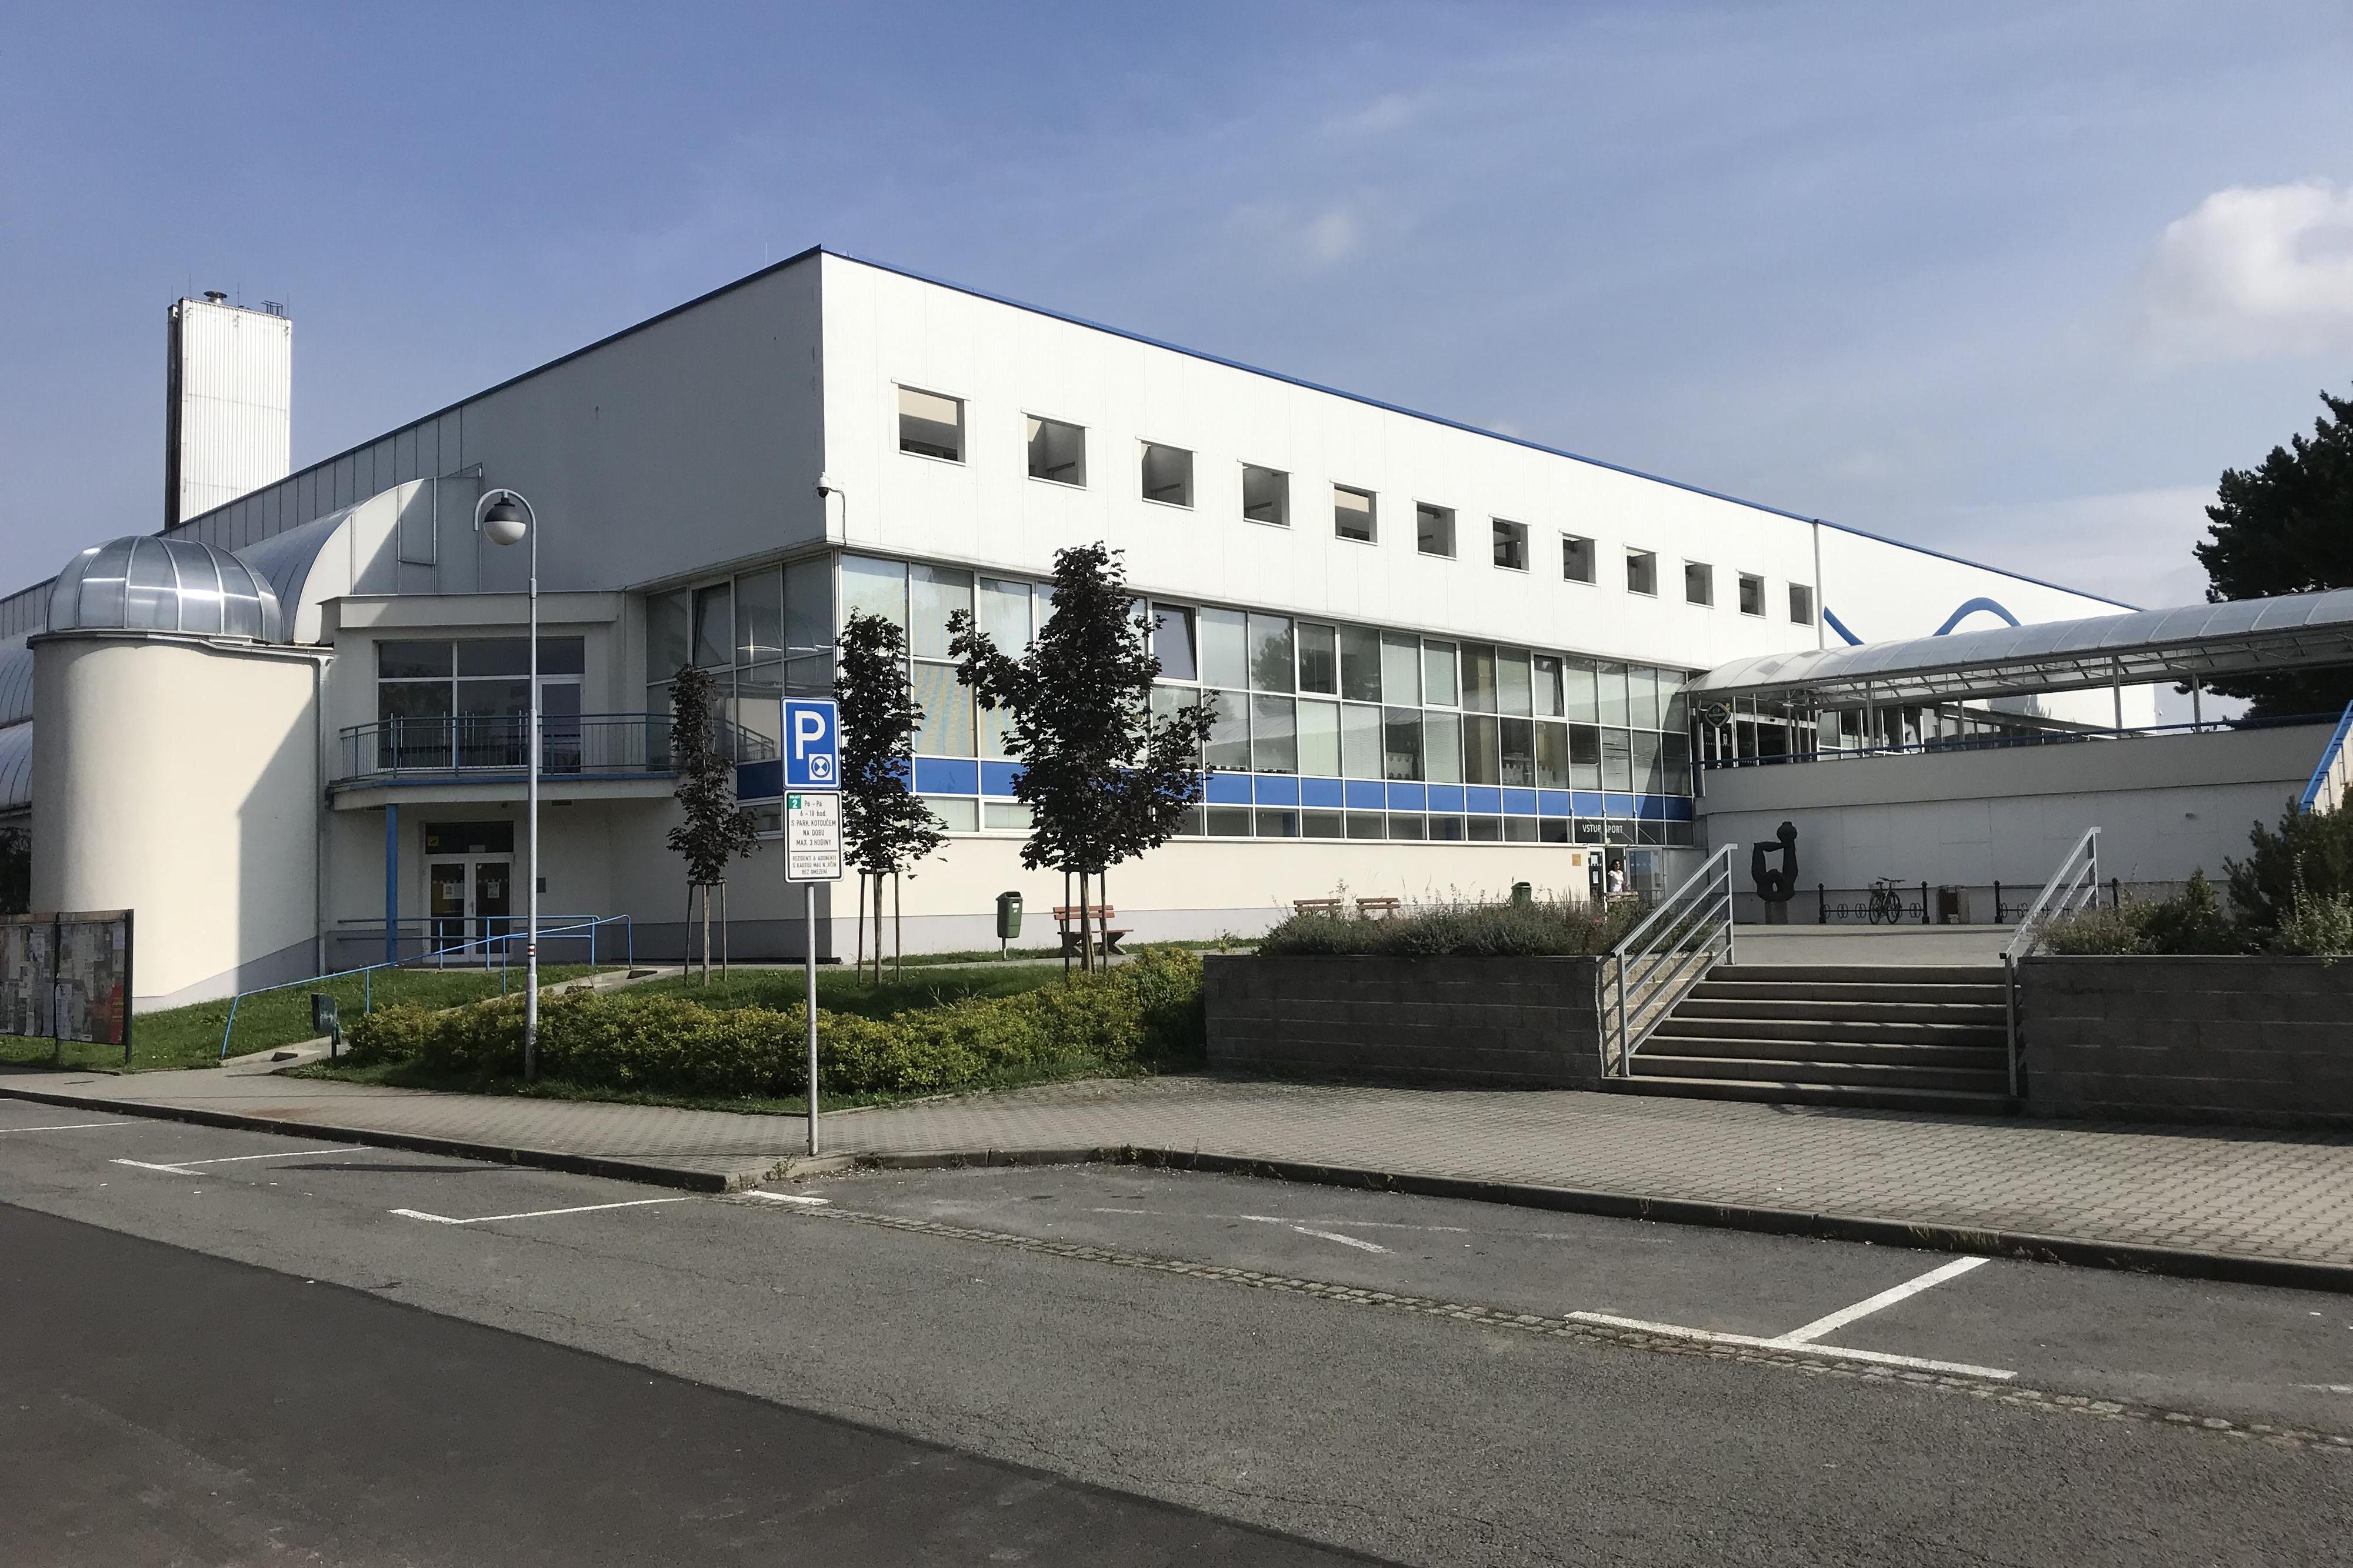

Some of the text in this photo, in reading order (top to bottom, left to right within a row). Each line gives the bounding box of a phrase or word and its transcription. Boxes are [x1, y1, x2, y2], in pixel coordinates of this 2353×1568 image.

[795, 710, 826, 760] P
[792, 799, 798, 808] 2
[1582, 824, 1623, 833] VSTUP SPORT
